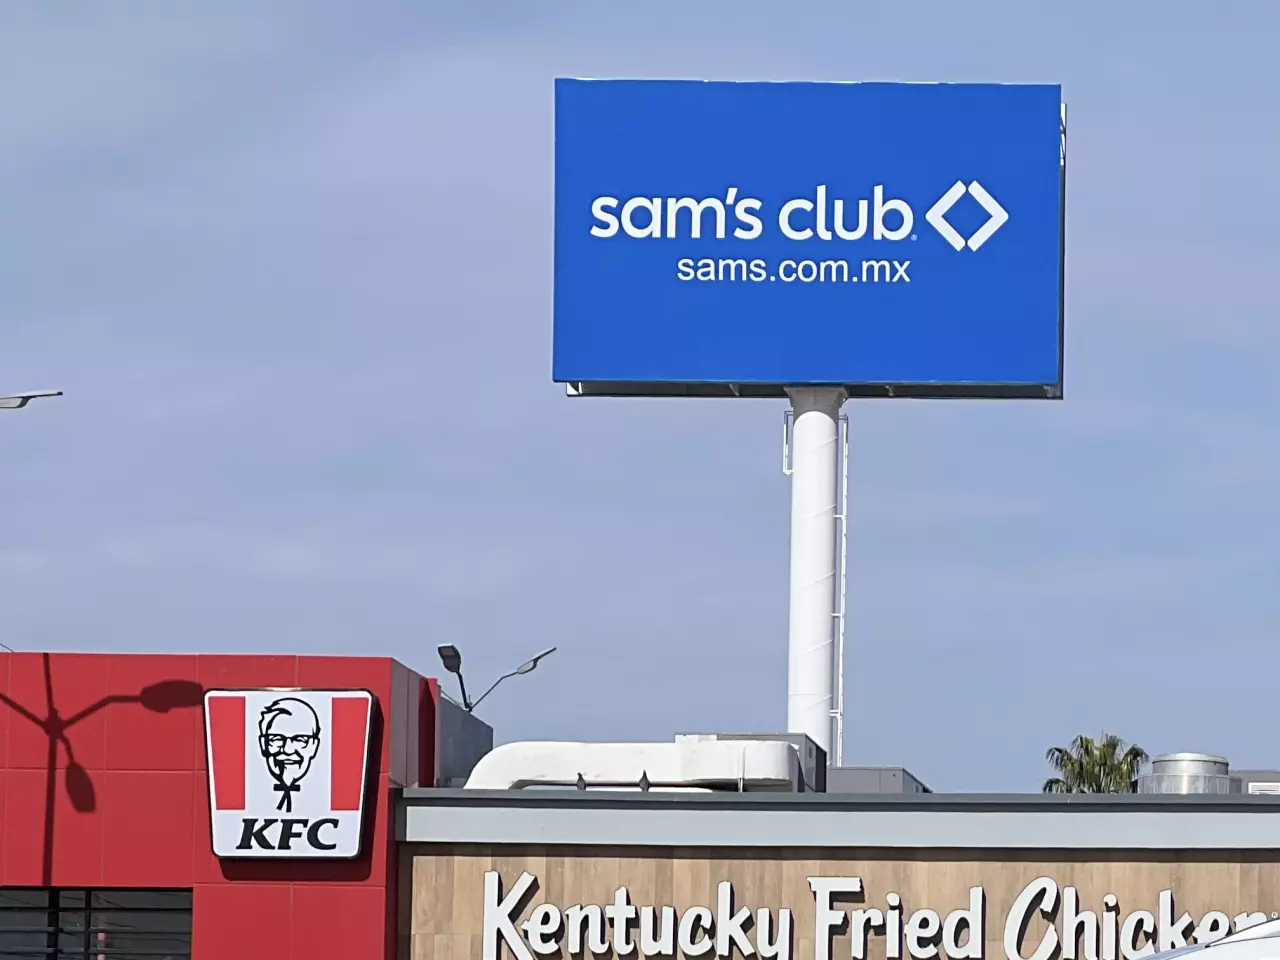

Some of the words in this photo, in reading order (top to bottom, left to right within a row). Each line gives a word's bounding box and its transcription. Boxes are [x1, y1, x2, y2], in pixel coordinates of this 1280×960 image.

[590, 187, 763, 239] sam's
[677, 257, 911, 282] sams.com.mx
[236, 817, 340, 850] KFC
